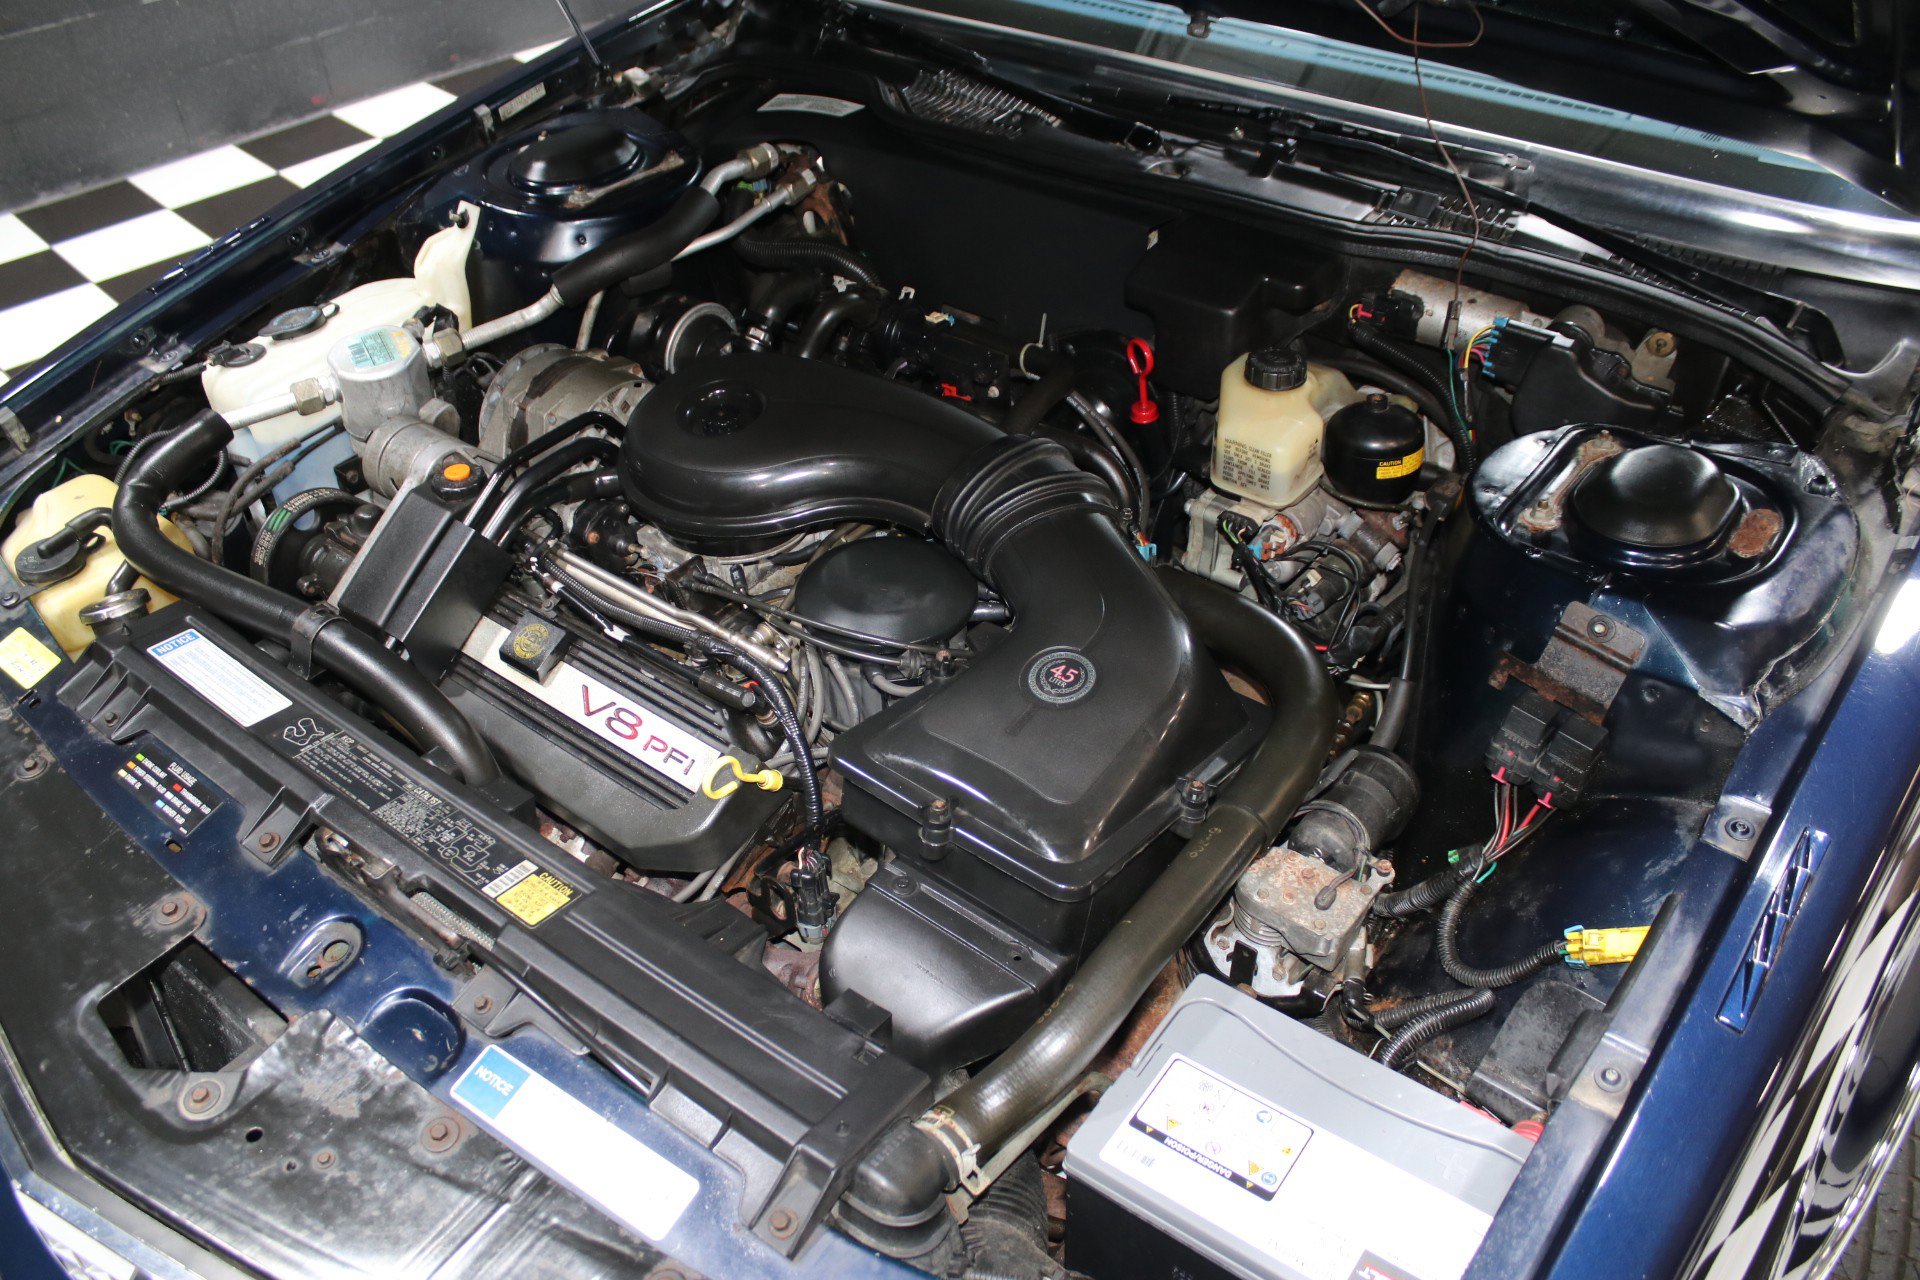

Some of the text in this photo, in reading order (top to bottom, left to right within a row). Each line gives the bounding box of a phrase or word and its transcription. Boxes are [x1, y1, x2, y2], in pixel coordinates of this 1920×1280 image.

[1379, 459, 1402, 467] CAUTION
[155, 632, 196, 655] NOTICE
[1048, 676, 1067, 688] LITER
[1049, 664, 1079, 683] 4.5
[581, 684, 696, 776] V8 PFI
[169, 762, 198, 785] FLUID USAGE
[413, 786, 442, 806] CATALYST
[539, 872, 574, 897] CAUTION
[474, 1064, 515, 1097] NOTICE
[1163, 1136, 1233, 1179] DANGER/POISON
